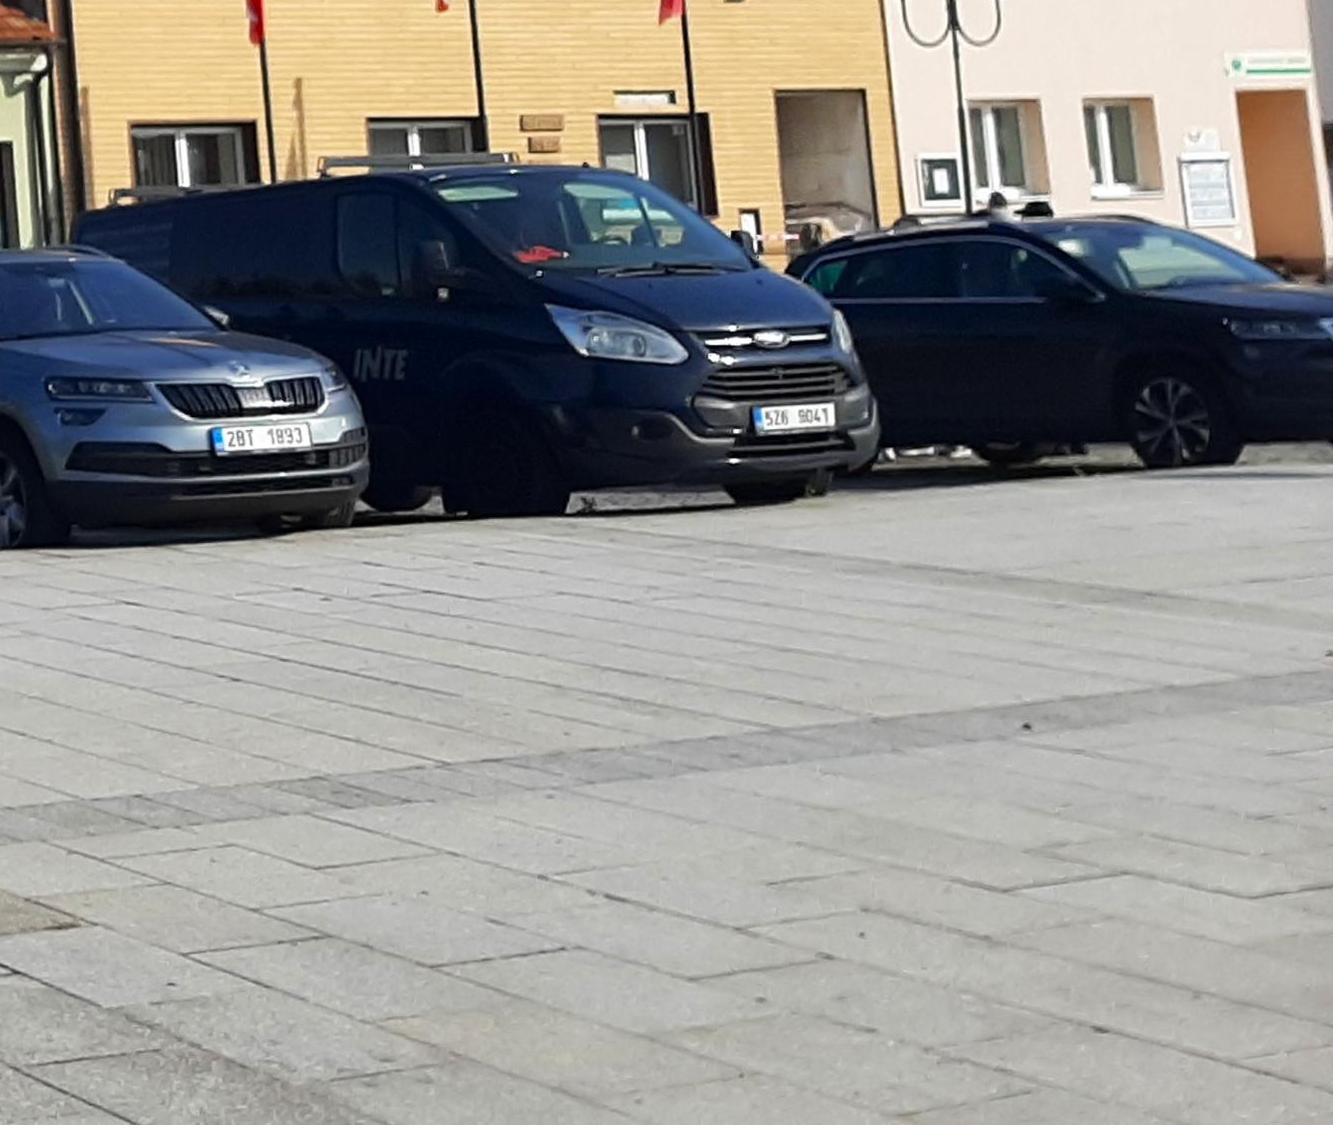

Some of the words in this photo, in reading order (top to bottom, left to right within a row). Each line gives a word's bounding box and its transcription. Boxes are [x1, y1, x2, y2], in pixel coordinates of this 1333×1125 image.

[354, 346, 408, 381] INTE
[226, 429, 254, 448] 2BT
[267, 427, 303, 445] 1893
